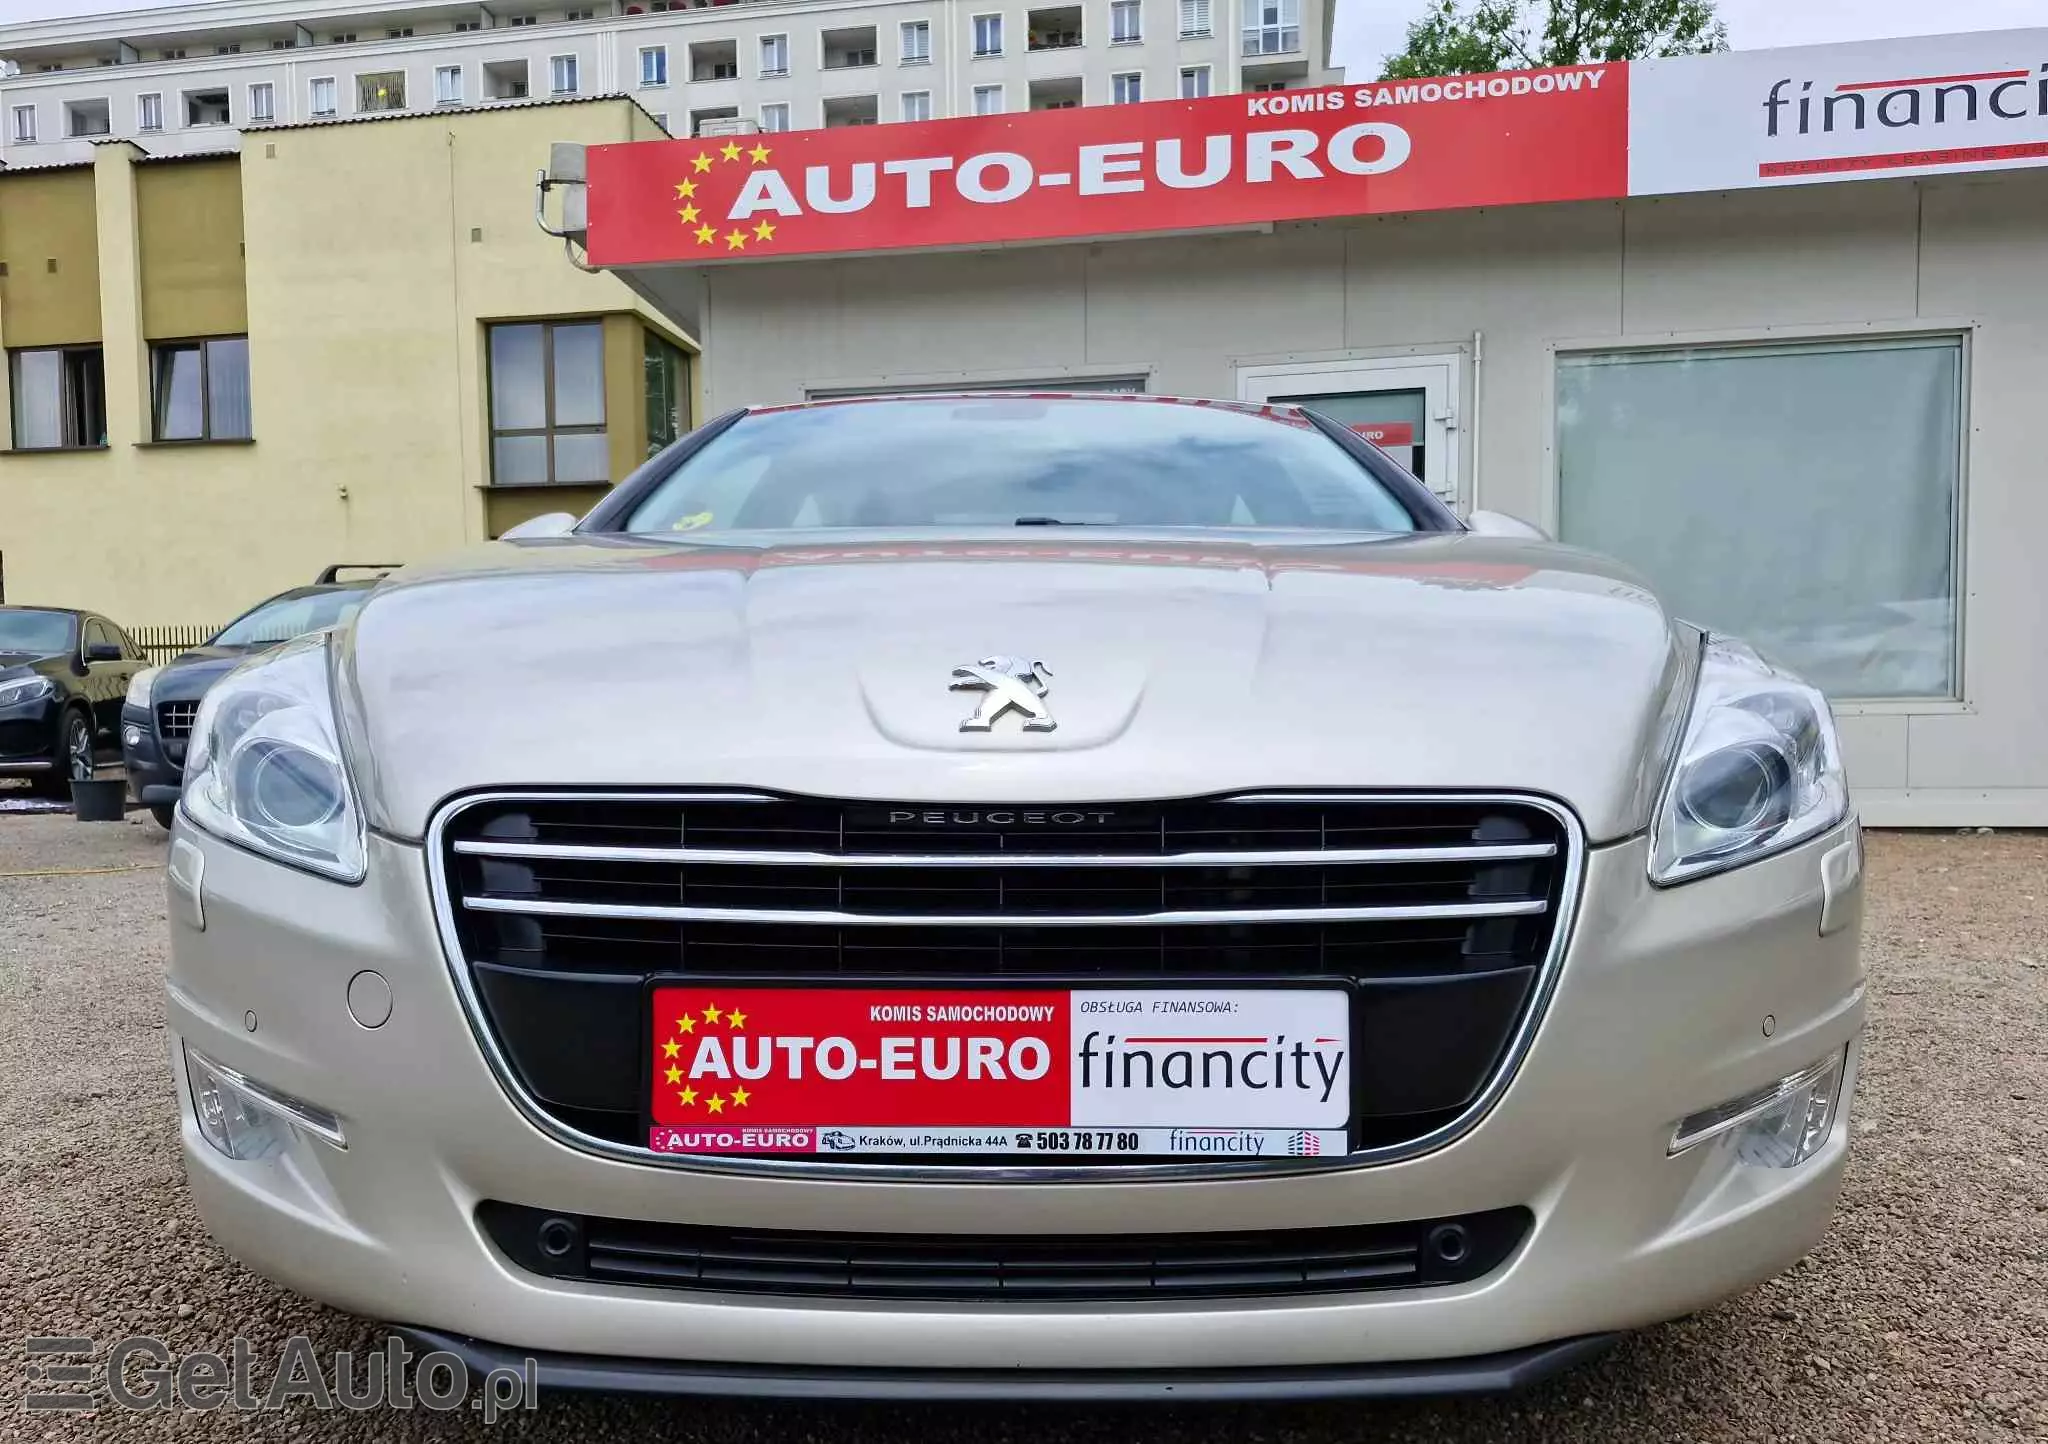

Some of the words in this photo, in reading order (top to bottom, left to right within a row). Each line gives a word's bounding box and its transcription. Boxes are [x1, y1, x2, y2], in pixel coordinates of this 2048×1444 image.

[1248, 91, 1345, 117] KOMIS
[1354, 69, 1606, 108] SAMOCHODOWY
[727, 122, 1412, 220] AUTO-EURO
[889, 811, 1115, 824] PEUGEOT
[870, 1005, 922, 1022] KOMIS
[926, 1005, 1055, 1022] SAMOCHODOWY
[1080, 1001, 1143, 1014] OBSŁUGA
[1152, 1001, 1239, 1014] FINANSOWA:
[688, 1036, 1051, 1081] AUTO-EURO
[1079, 1031, 1345, 1103] financity
[667, 1132, 809, 1147] AUTO-EURO
[859, 1135, 906, 1147] Kraków,
[985, 1135, 1008, 1147] 44A
[1037, 1132, 1070, 1150] 503
[1074, 1132, 1093, 1150] 78
[1097, 1132, 1114, 1150] 77
[1117, 1132, 1139, 1150] 80
[1170, 1129, 1265, 1156] financity
